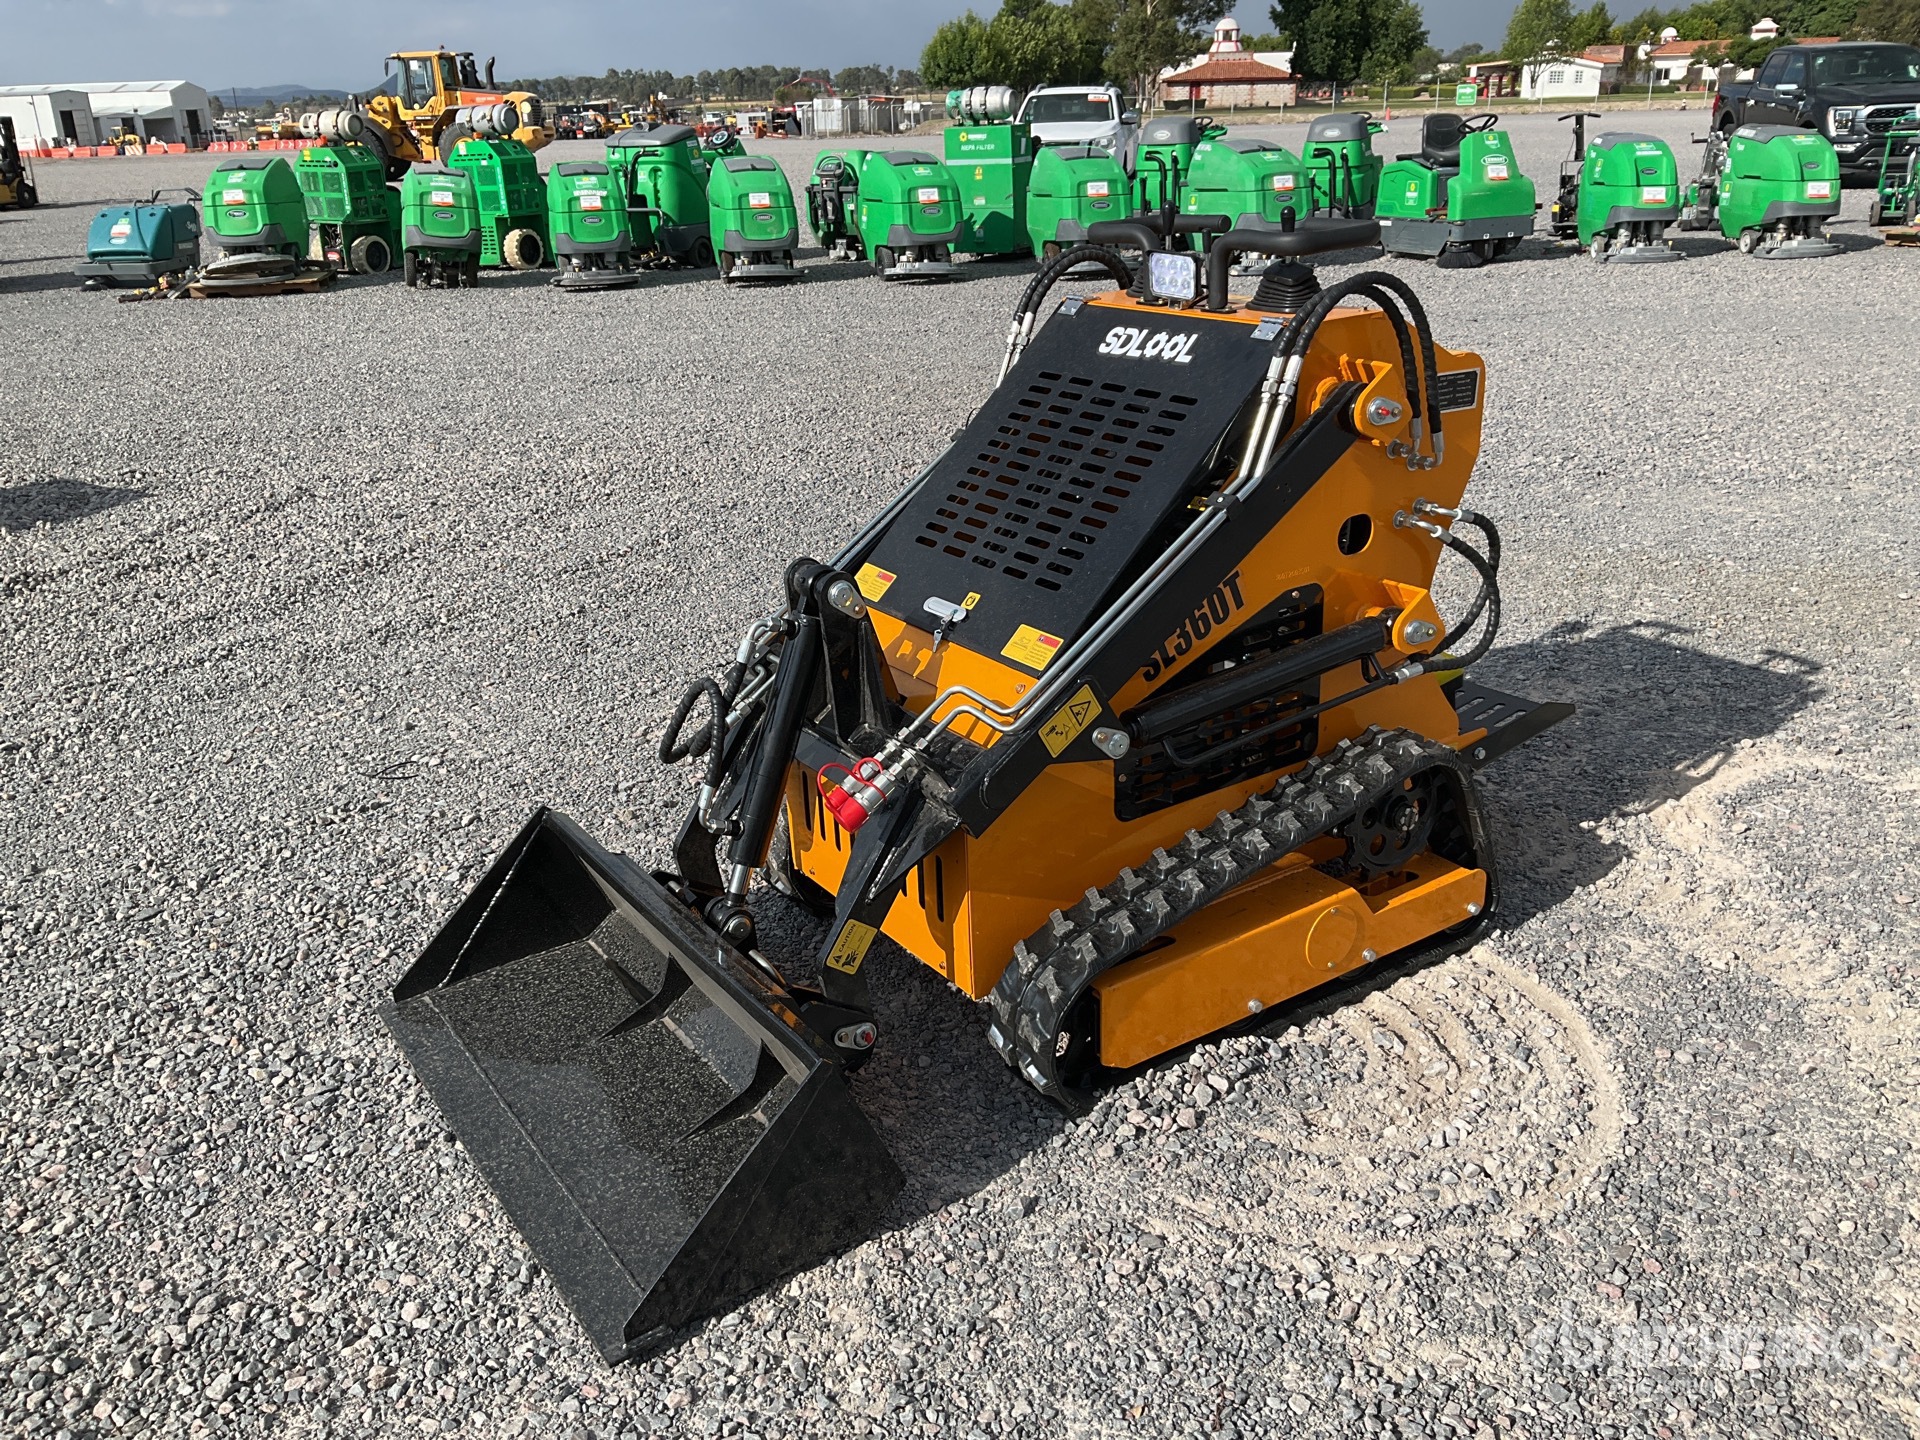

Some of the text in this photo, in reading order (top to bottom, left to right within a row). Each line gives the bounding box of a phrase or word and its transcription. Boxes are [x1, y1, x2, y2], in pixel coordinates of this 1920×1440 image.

[1098, 326, 1199, 363] SDLOOL
[1140, 570, 1245, 682] SL360T
[838, 923, 857, 953] CAUTION
